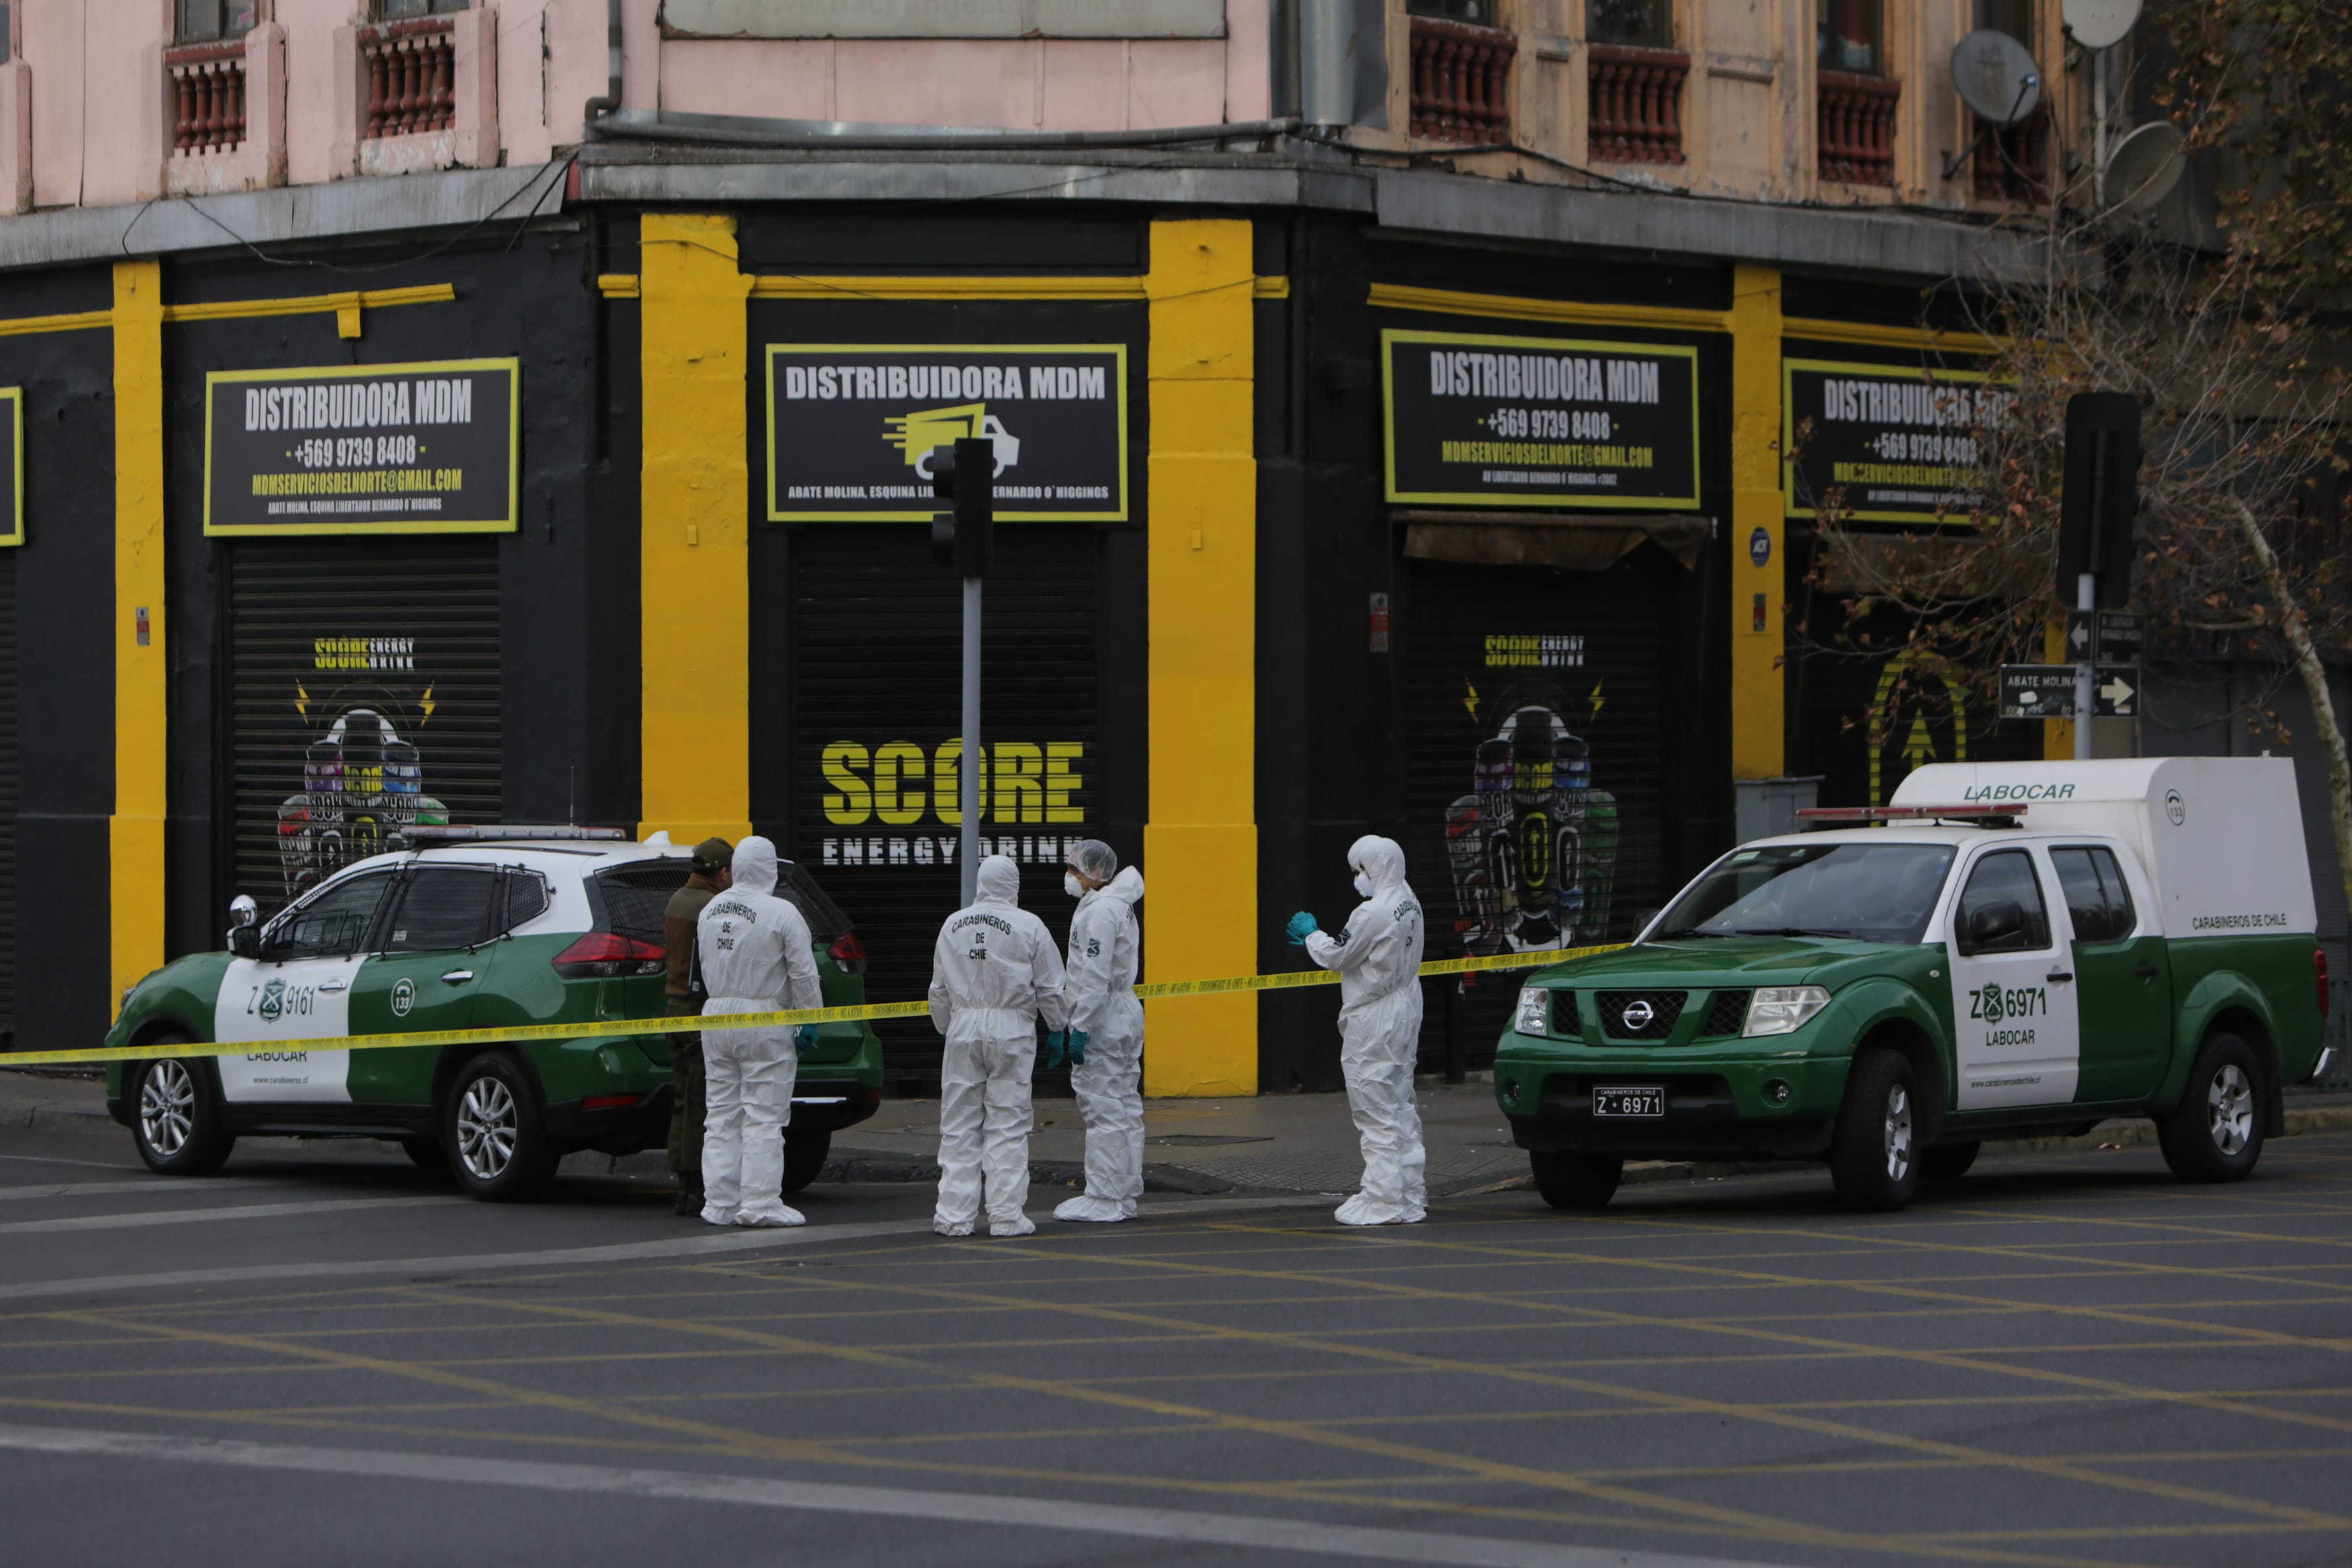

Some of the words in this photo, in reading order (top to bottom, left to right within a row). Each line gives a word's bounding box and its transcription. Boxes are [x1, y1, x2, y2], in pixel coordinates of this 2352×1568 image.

[786, 366, 1023, 399] DISTRIBUIDORA
[1030, 366, 1105, 399] MDM
[1430, 351, 1604, 402] DISTRIBUIDORA
[1607, 359, 1659, 404] MDM
[245, 381, 410, 431] DISTRIBUIDORA
[415, 379, 472, 424] MDM
[1488, 408, 1528, 437] +569
[1531, 410, 1569, 439] 9739
[1572, 411, 1611, 440] 8408
[295, 439, 333, 468] +569
[337, 437, 373, 466] 9739
[377, 435, 416, 464] 8408
[1442, 441, 1653, 468] MDMSERVICIOSDELNORTE@GMAIL.COM
[1872, 432, 1907, 460] +569
[1910, 434, 1942, 462] 9739
[252, 468, 462, 496] MDMSERVICIOSDELNORTE@GMAIL.COM
[788, 486, 822, 498] ABATE
[824, 486, 867, 499] MOLINA,
[870, 486, 916, 499] ESQUINA
[993, 486, 1042, 498] ERNARDO
[268, 501, 286, 514] ABATE
[310, 500, 335, 515] ESQUINA
[335, 499, 371, 513] LIBERTADOR
[372, 498, 403, 512] BERNARDO
[370, 638, 413, 653] ENERGY
[1542, 636, 1584, 650] ENERGY
[370, 654, 413, 670] DRINK
[2007, 676, 2039, 687] ABATE
[822, 738, 1083, 827] SCORE
[1964, 784, 2075, 799] LABOCAR
[2170, 807, 2182, 817] 133
[823, 838, 957, 865] ENERGY
[707, 902, 757, 924] CARABINEROS
[2193, 915, 2250, 929] CARABINEROS
[2252, 914, 2263, 926] DE
[2264, 914, 2287, 926] CHILE
[723, 922, 731, 932] DE
[952, 914, 1011, 935] CARABINEROS
[718, 938, 734, 950] CHILE
[976, 932, 984, 944] DE
[247, 986, 258, 1014] Z
[286, 986, 315, 1015] 9161
[395, 997, 409, 1009] 133
[1970, 990, 1982, 1018] Z
[2006, 988, 2046, 1017] 6971
[1986, 1029, 2035, 1046] LABOCAR
[1597, 1096, 1607, 1113] Z
[1623, 1097, 1659, 1113] 6971
